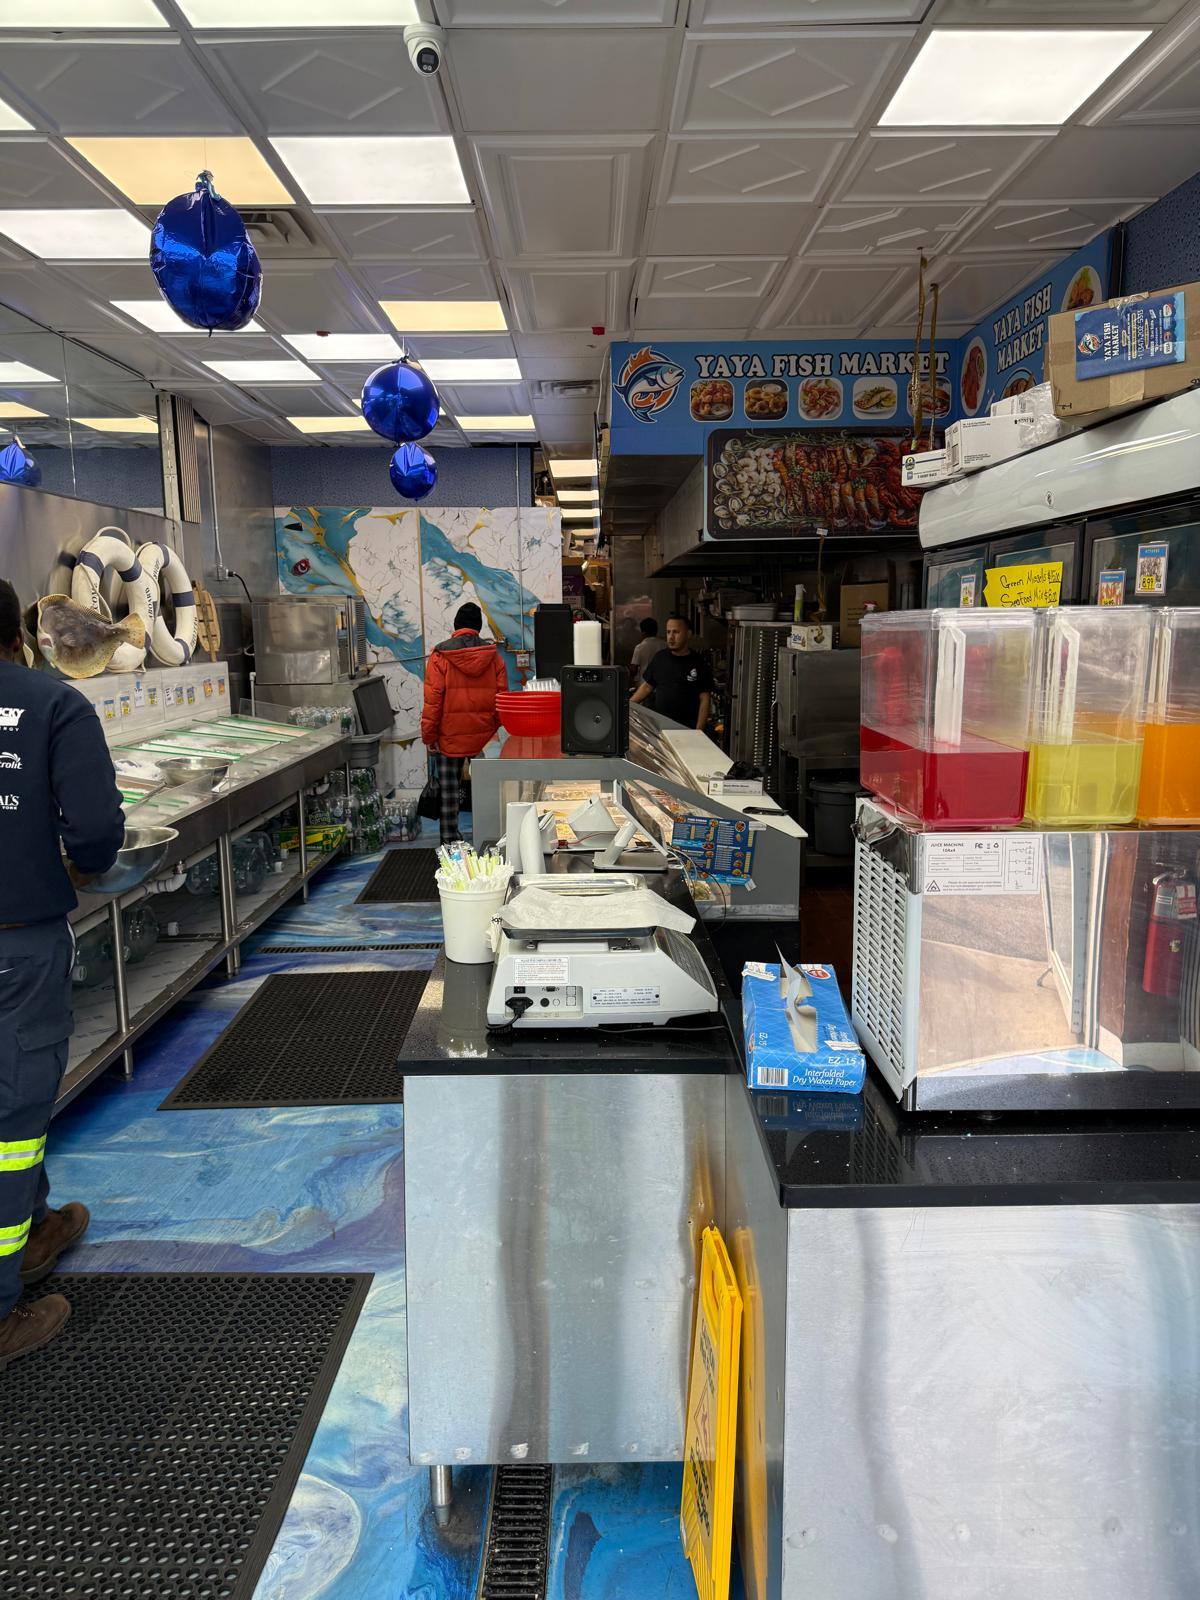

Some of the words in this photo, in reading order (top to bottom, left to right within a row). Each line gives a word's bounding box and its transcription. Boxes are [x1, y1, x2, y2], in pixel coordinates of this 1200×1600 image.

[993, 305, 1021, 346] YAYA
[1023, 283, 1052, 328] FISH
[1103, 322, 1111, 339] FISH
[1111, 325, 1120, 356] MARKET
[997, 321, 1045, 374] MARKET
[1104, 341, 1112, 361] YAYA
[696, 355, 766, 378] YAYA
[772, 353, 833, 377] FISH
[839, 351, 949, 375] MARKET
[792, 1075, 807, 1085] Dry
[808, 1076, 833, 1085] Waxed
[834, 1077, 857, 1087] Paper
[804, 1068, 845, 1078] Interfolded
